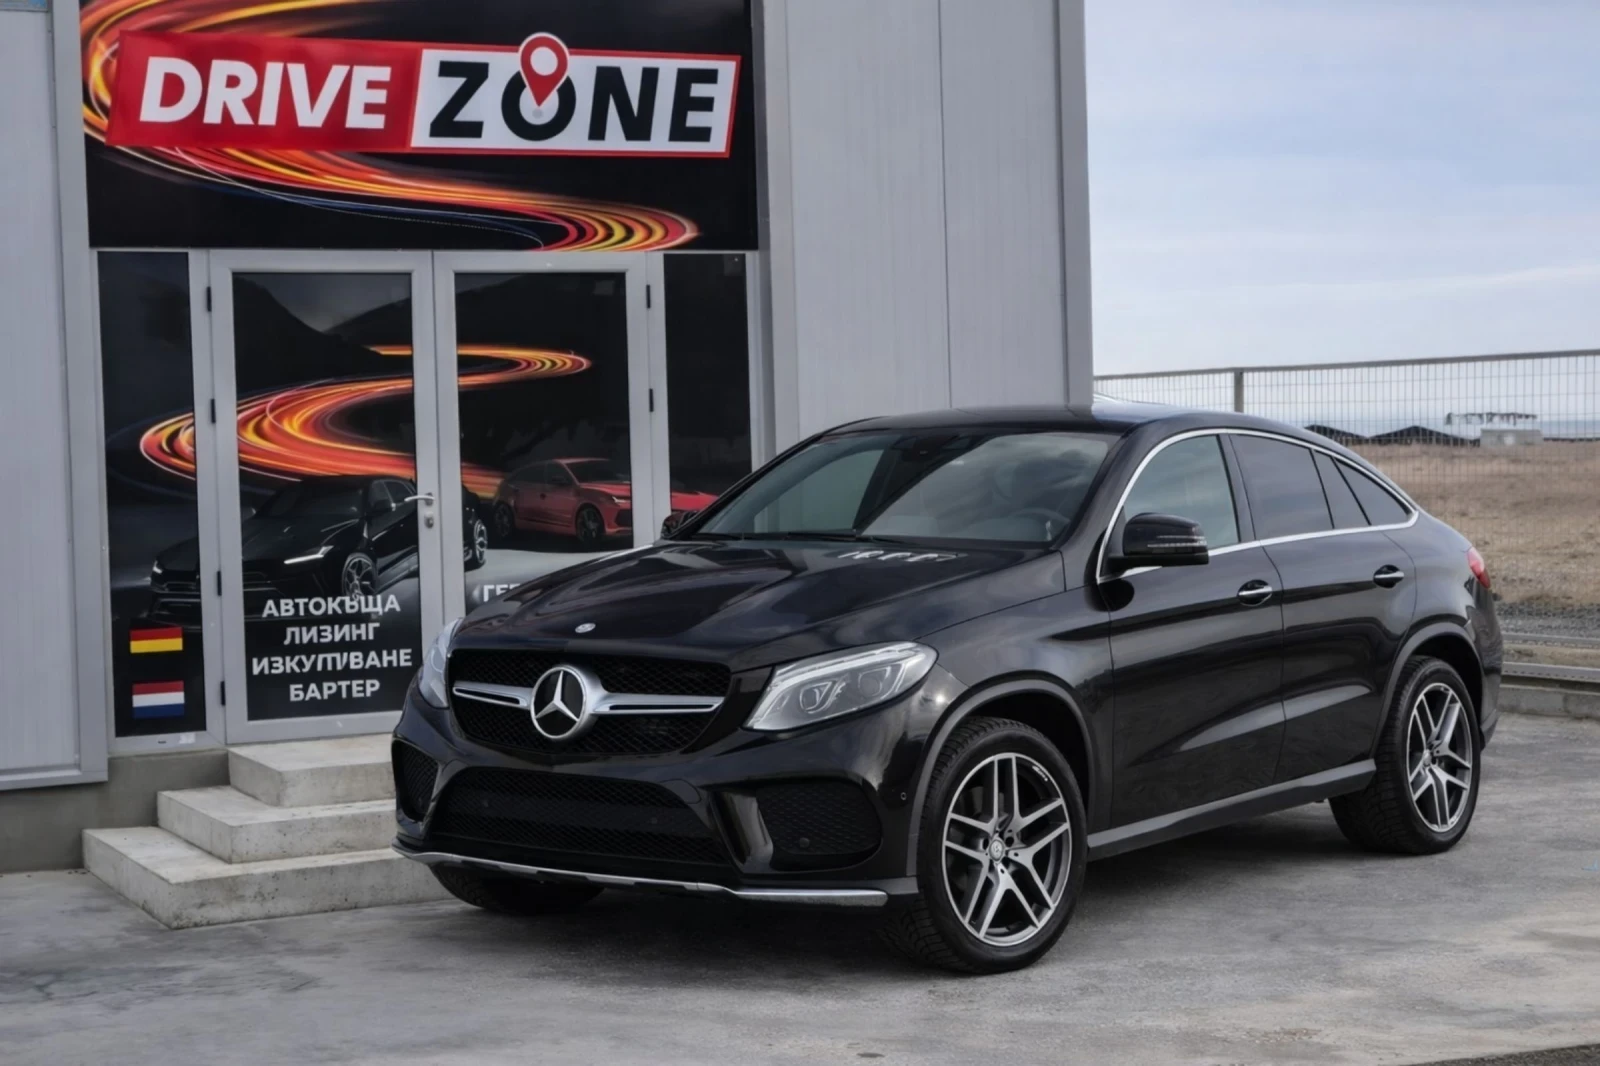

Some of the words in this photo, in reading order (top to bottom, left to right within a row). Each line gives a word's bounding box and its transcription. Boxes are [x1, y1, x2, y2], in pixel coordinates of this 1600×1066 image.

[139, 56, 392, 129] DRIVE
[428, 60, 719, 142] ZONE
[262, 594, 401, 618] АВТОКЪЩА
[283, 622, 381, 645] ЛИЗИНГ
[289, 679, 381, 702] БАРТЕР
